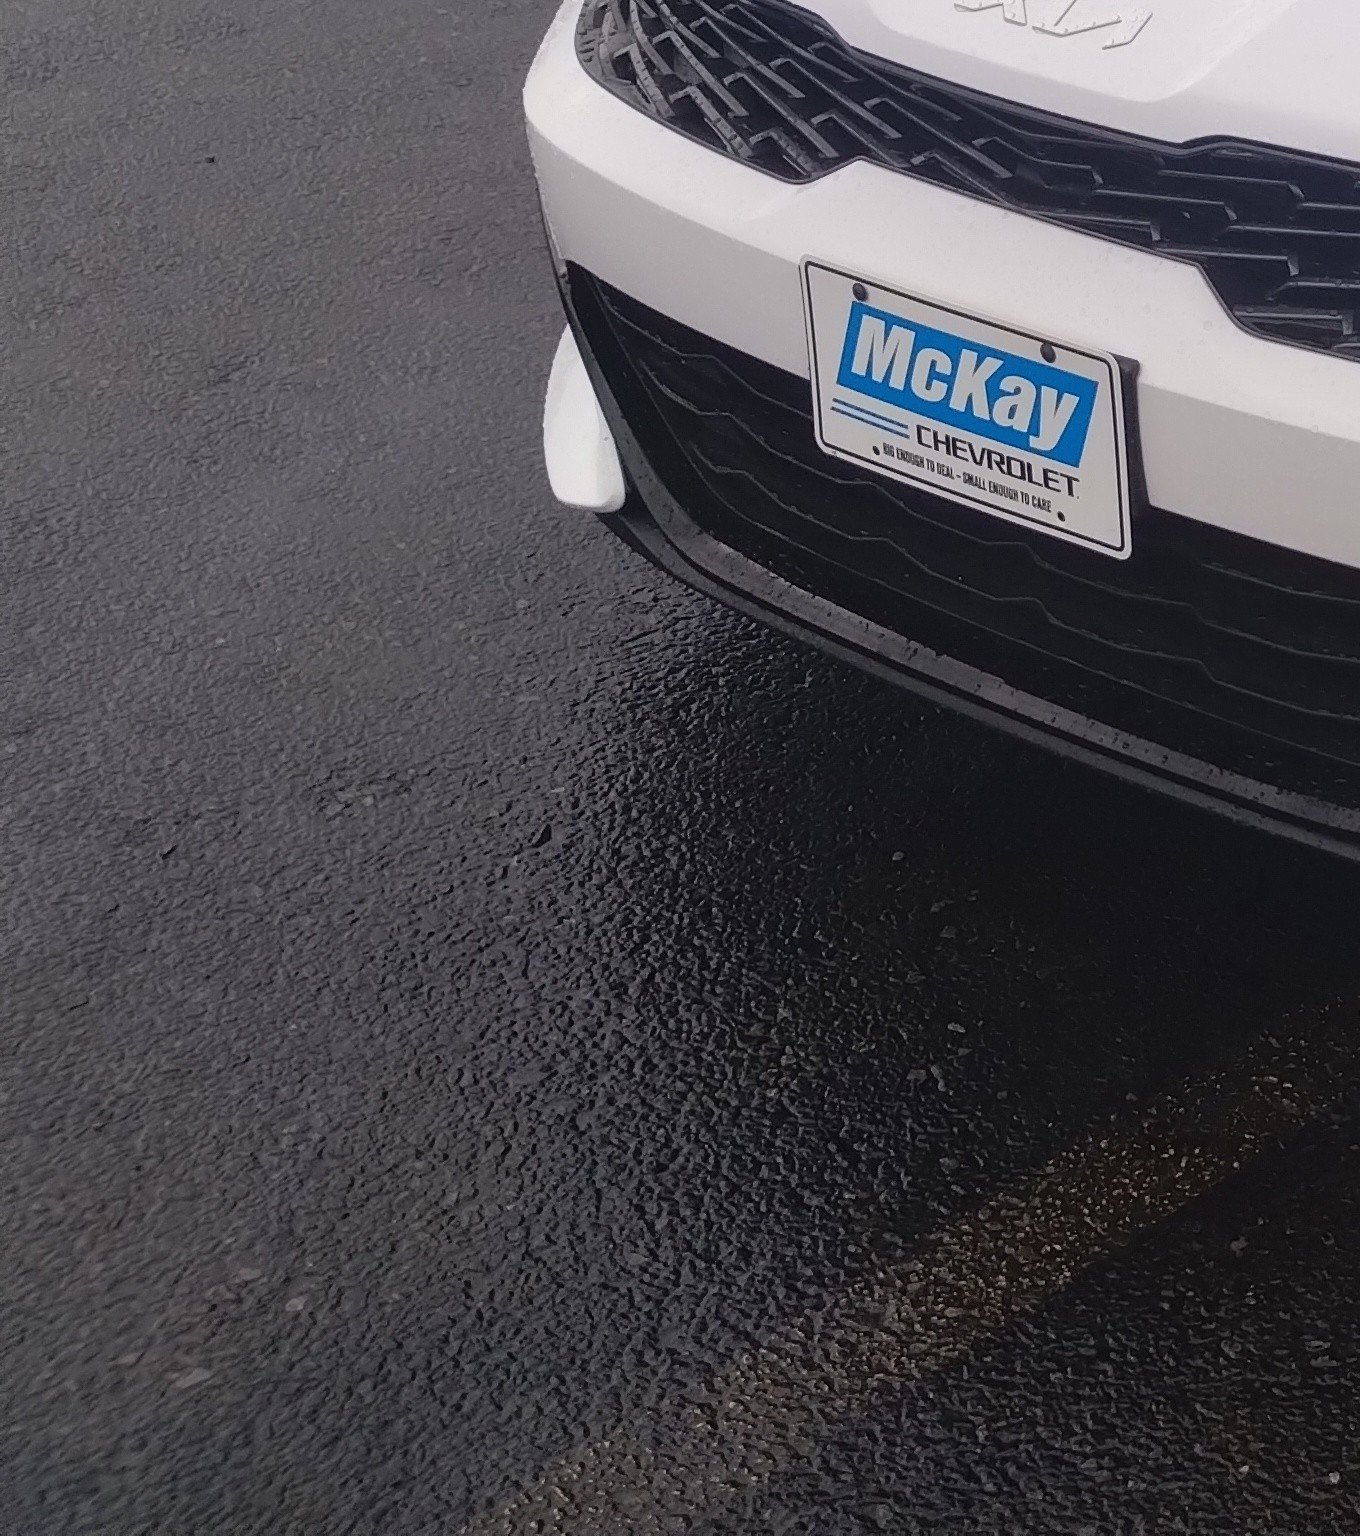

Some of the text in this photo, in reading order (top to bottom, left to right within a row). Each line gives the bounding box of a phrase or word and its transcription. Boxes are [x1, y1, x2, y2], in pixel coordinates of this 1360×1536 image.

[850, 313, 1080, 452] McKay
[896, 447, 925, 468] ENOUGH
[926, 458, 936, 473] TO
[936, 462, 955, 480] DEAL
[962, 471, 987, 492] SMALL
[988, 480, 1019, 502] ENOUGH
[1020, 490, 1030, 505] TO
[1031, 495, 1052, 513] CARE
[916, 424, 1080, 498] CHEVROLET
